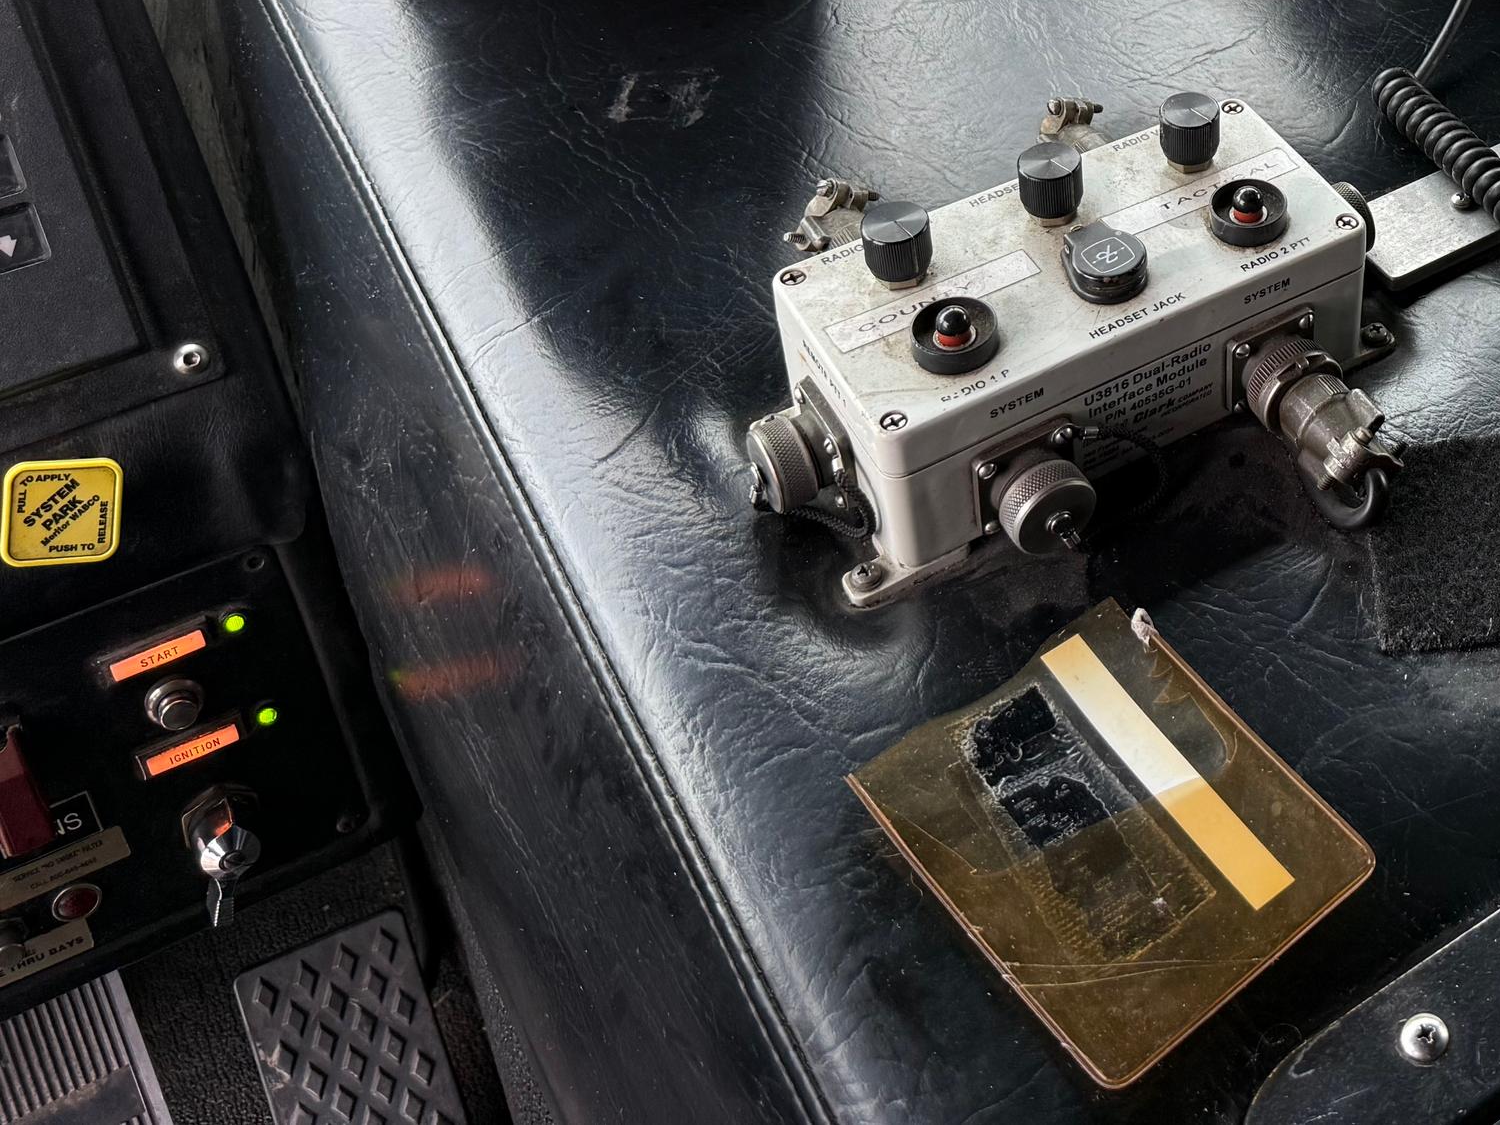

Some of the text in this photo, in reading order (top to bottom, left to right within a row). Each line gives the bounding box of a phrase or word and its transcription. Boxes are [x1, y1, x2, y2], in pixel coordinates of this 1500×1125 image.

[1112, 133, 1150, 152] RADIO
[969, 183, 1019, 208] HEADSE
[1160, 162, 1278, 210] TACTCAL
[820, 245, 865, 266] RADIO
[1240, 236, 1310, 272] RADIO 2 PTT
[1244, 277, 1292, 305] SYSTEM
[1089, 291, 1187, 340] HEADSET JACK
[1084, 342, 1212, 408] U3816 Dual-Radio
[1088, 355, 1208, 419] Interface Module
[1177, 382, 1214, 404] COMPANY
[989, 387, 1045, 419] SYSTEM
[1105, 376, 1192, 425] P/N 40535G-01
[1132, 396, 1178, 424] Clark
[17, 473, 71, 514] PULL TO APPLY
[23, 478, 81, 528] SYSTEM
[40, 494, 100, 547] Meritor WABCO
[41, 495, 85, 531] PARK
[48, 500, 109, 553] PUSH TO RELEASE
[140, 645, 180, 668] START
[169, 737, 221, 765] IGNITION
